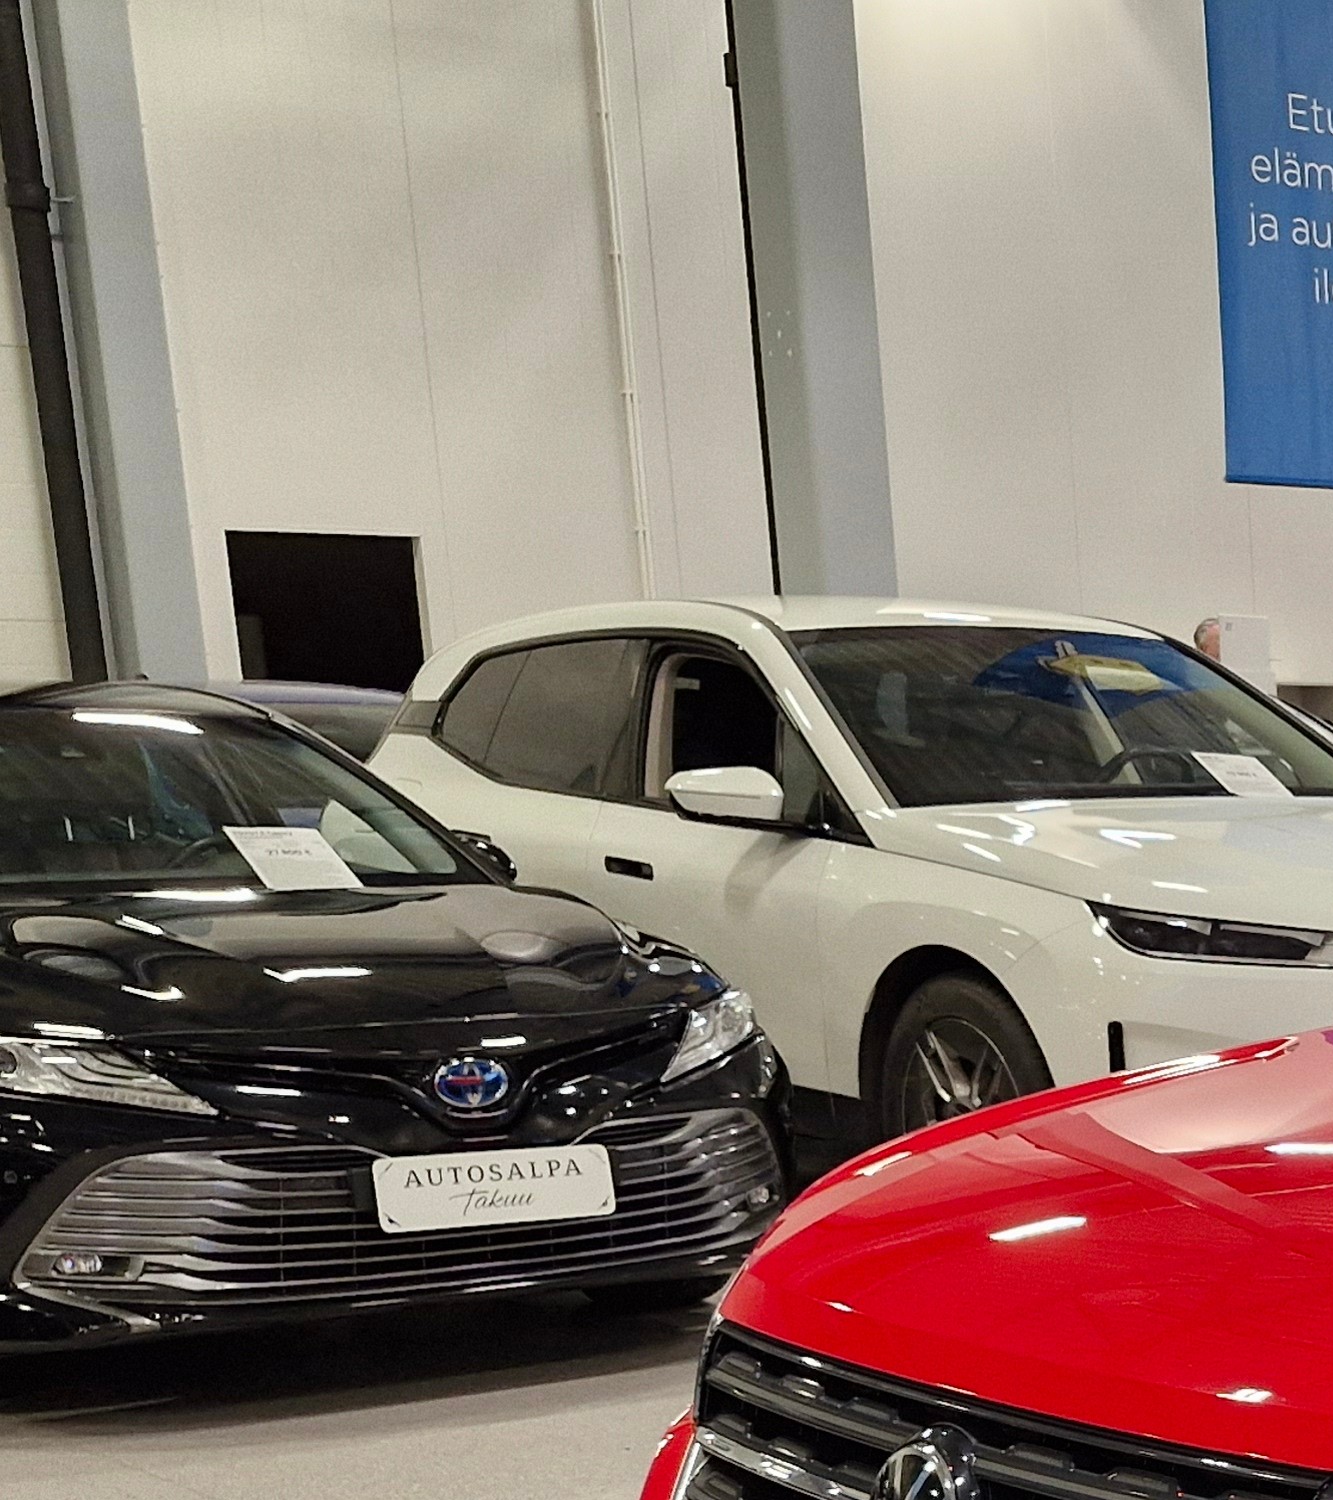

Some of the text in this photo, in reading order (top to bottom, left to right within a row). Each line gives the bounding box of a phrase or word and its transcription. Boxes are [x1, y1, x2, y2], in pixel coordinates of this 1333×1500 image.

[1247, 202, 1279, 246] ja
[404, 1158, 584, 1189] AUTOSALPA
[450, 1187, 535, 1217] Takuu
